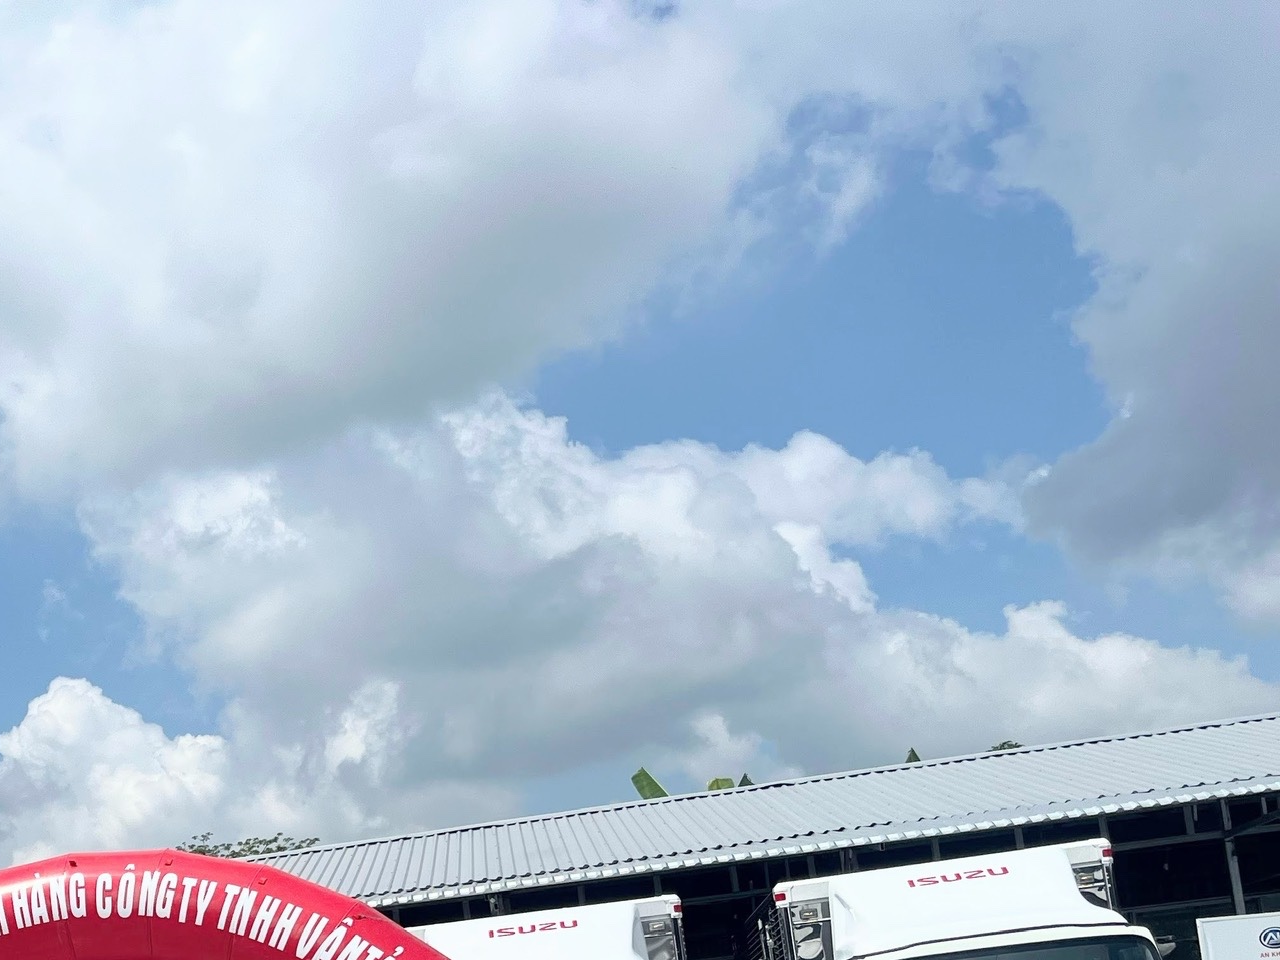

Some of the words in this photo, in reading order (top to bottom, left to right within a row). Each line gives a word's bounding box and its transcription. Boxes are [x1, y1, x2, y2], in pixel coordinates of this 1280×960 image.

[907, 867, 1009, 888] ISUZU
[10, 872, 87, 930] HÀNG
[95, 863, 178, 919] CÔNG
[178, 876, 218, 926] TY
[217, 882, 303, 952] TNHH
[489, 920, 578, 938] ISUZU
